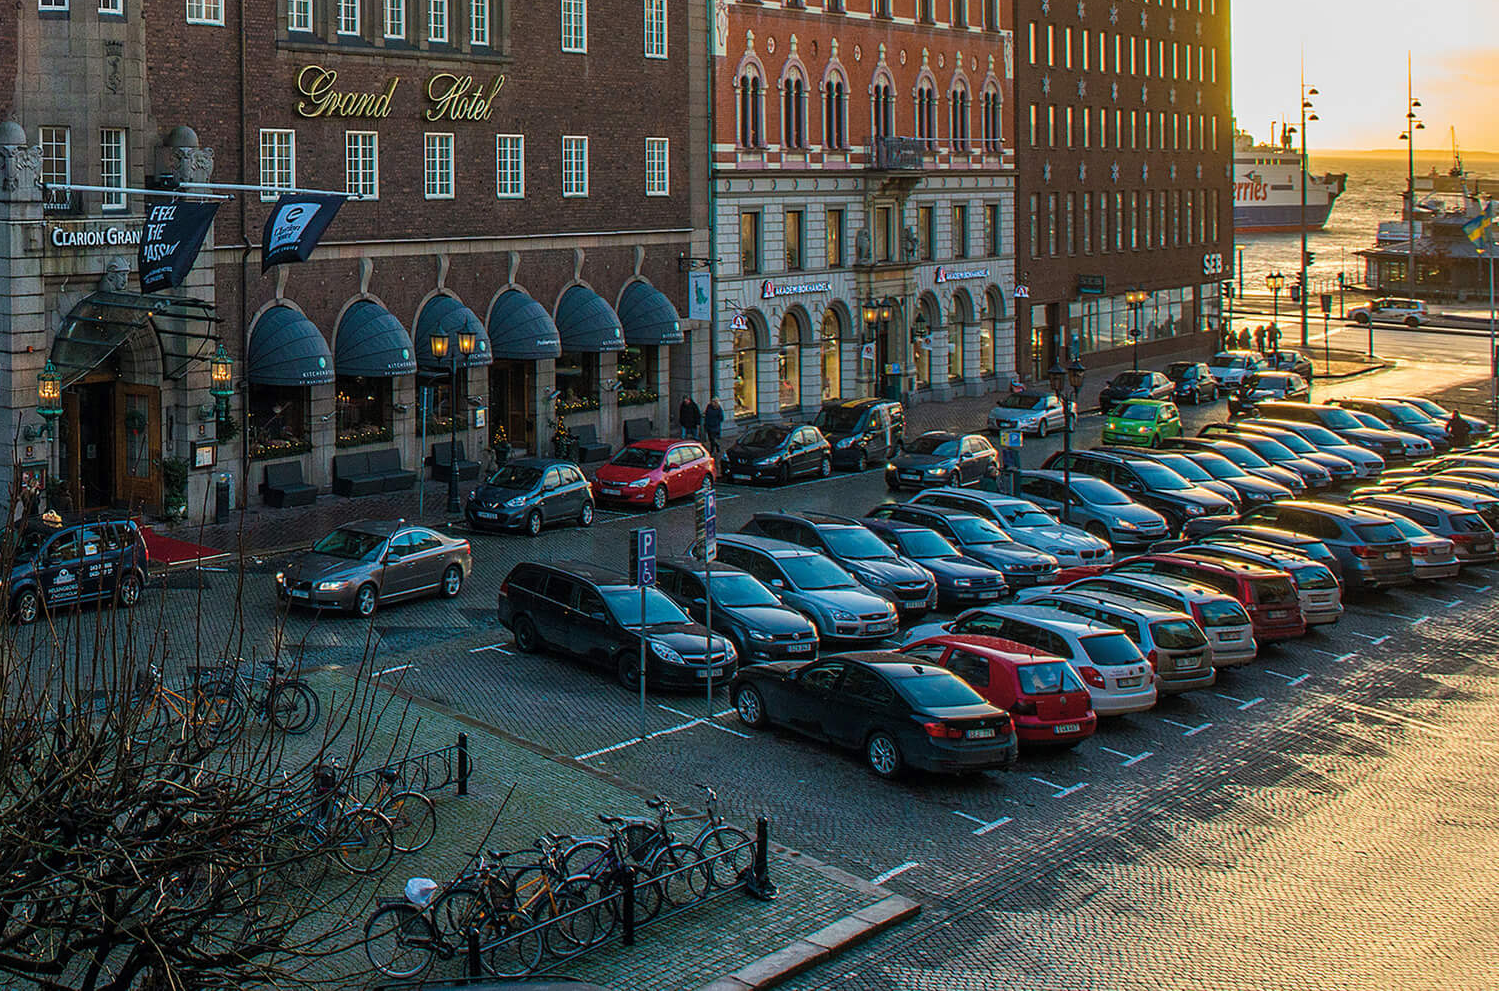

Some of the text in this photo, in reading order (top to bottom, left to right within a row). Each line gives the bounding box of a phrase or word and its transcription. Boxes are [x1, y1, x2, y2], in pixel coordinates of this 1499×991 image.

[298, 65, 505, 121] Grand Hotel
[149, 205, 178, 222] FEEL
[51, 226, 143, 247] CLARION GRAN
[147, 222, 166, 242] THE
[1203, 253, 1222, 275] SEB
[643, 533, 653, 556] P
